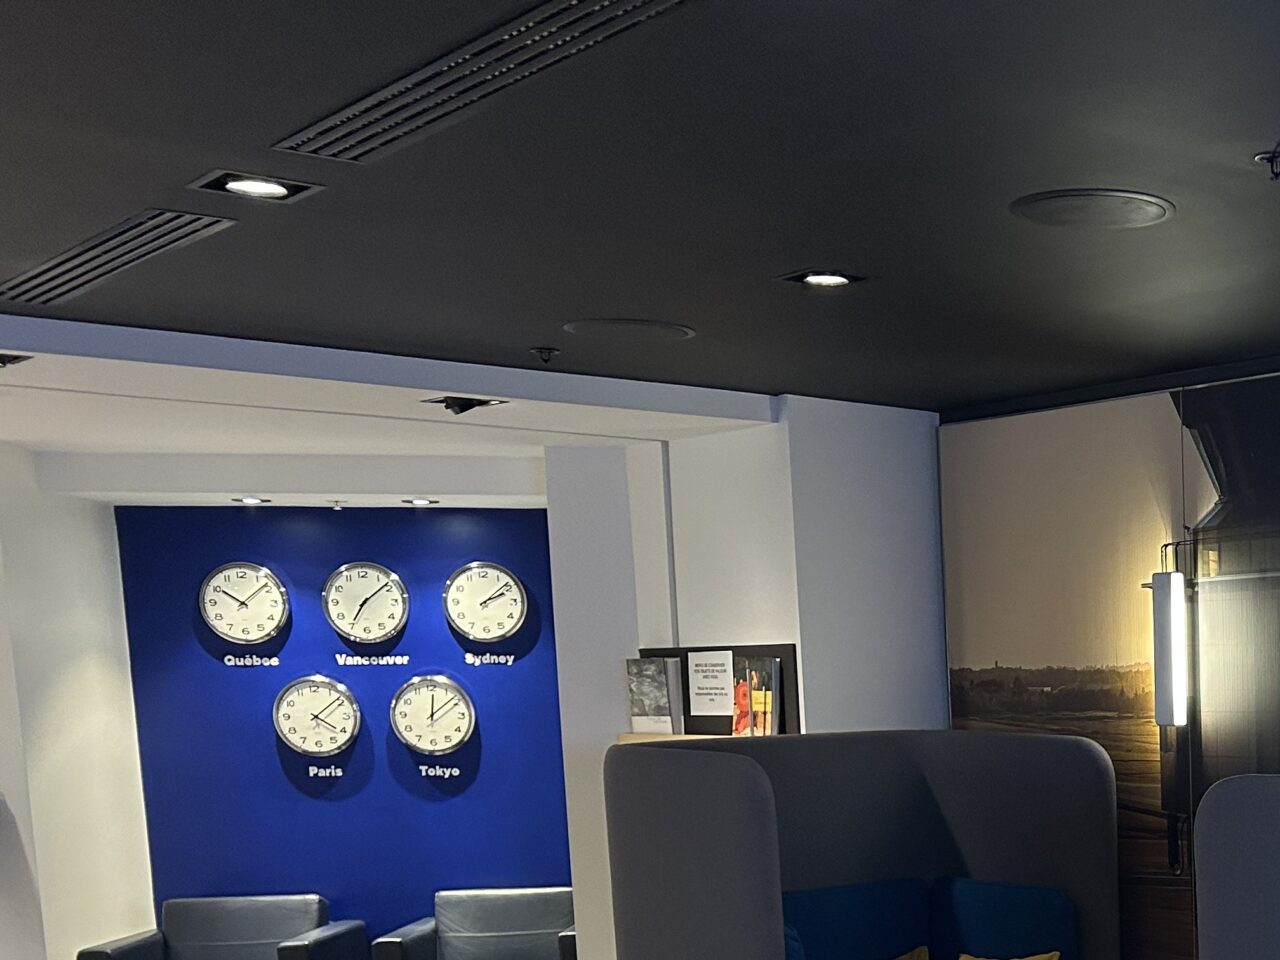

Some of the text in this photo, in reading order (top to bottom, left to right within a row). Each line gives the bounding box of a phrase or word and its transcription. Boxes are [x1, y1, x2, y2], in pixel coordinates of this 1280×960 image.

[224, 655, 280, 665] Québec
[335, 654, 409, 665] Vancouver
[465, 653, 514, 666] Sydney
[309, 766, 343, 777] Paris
[419, 766, 460, 778] Tokyo
